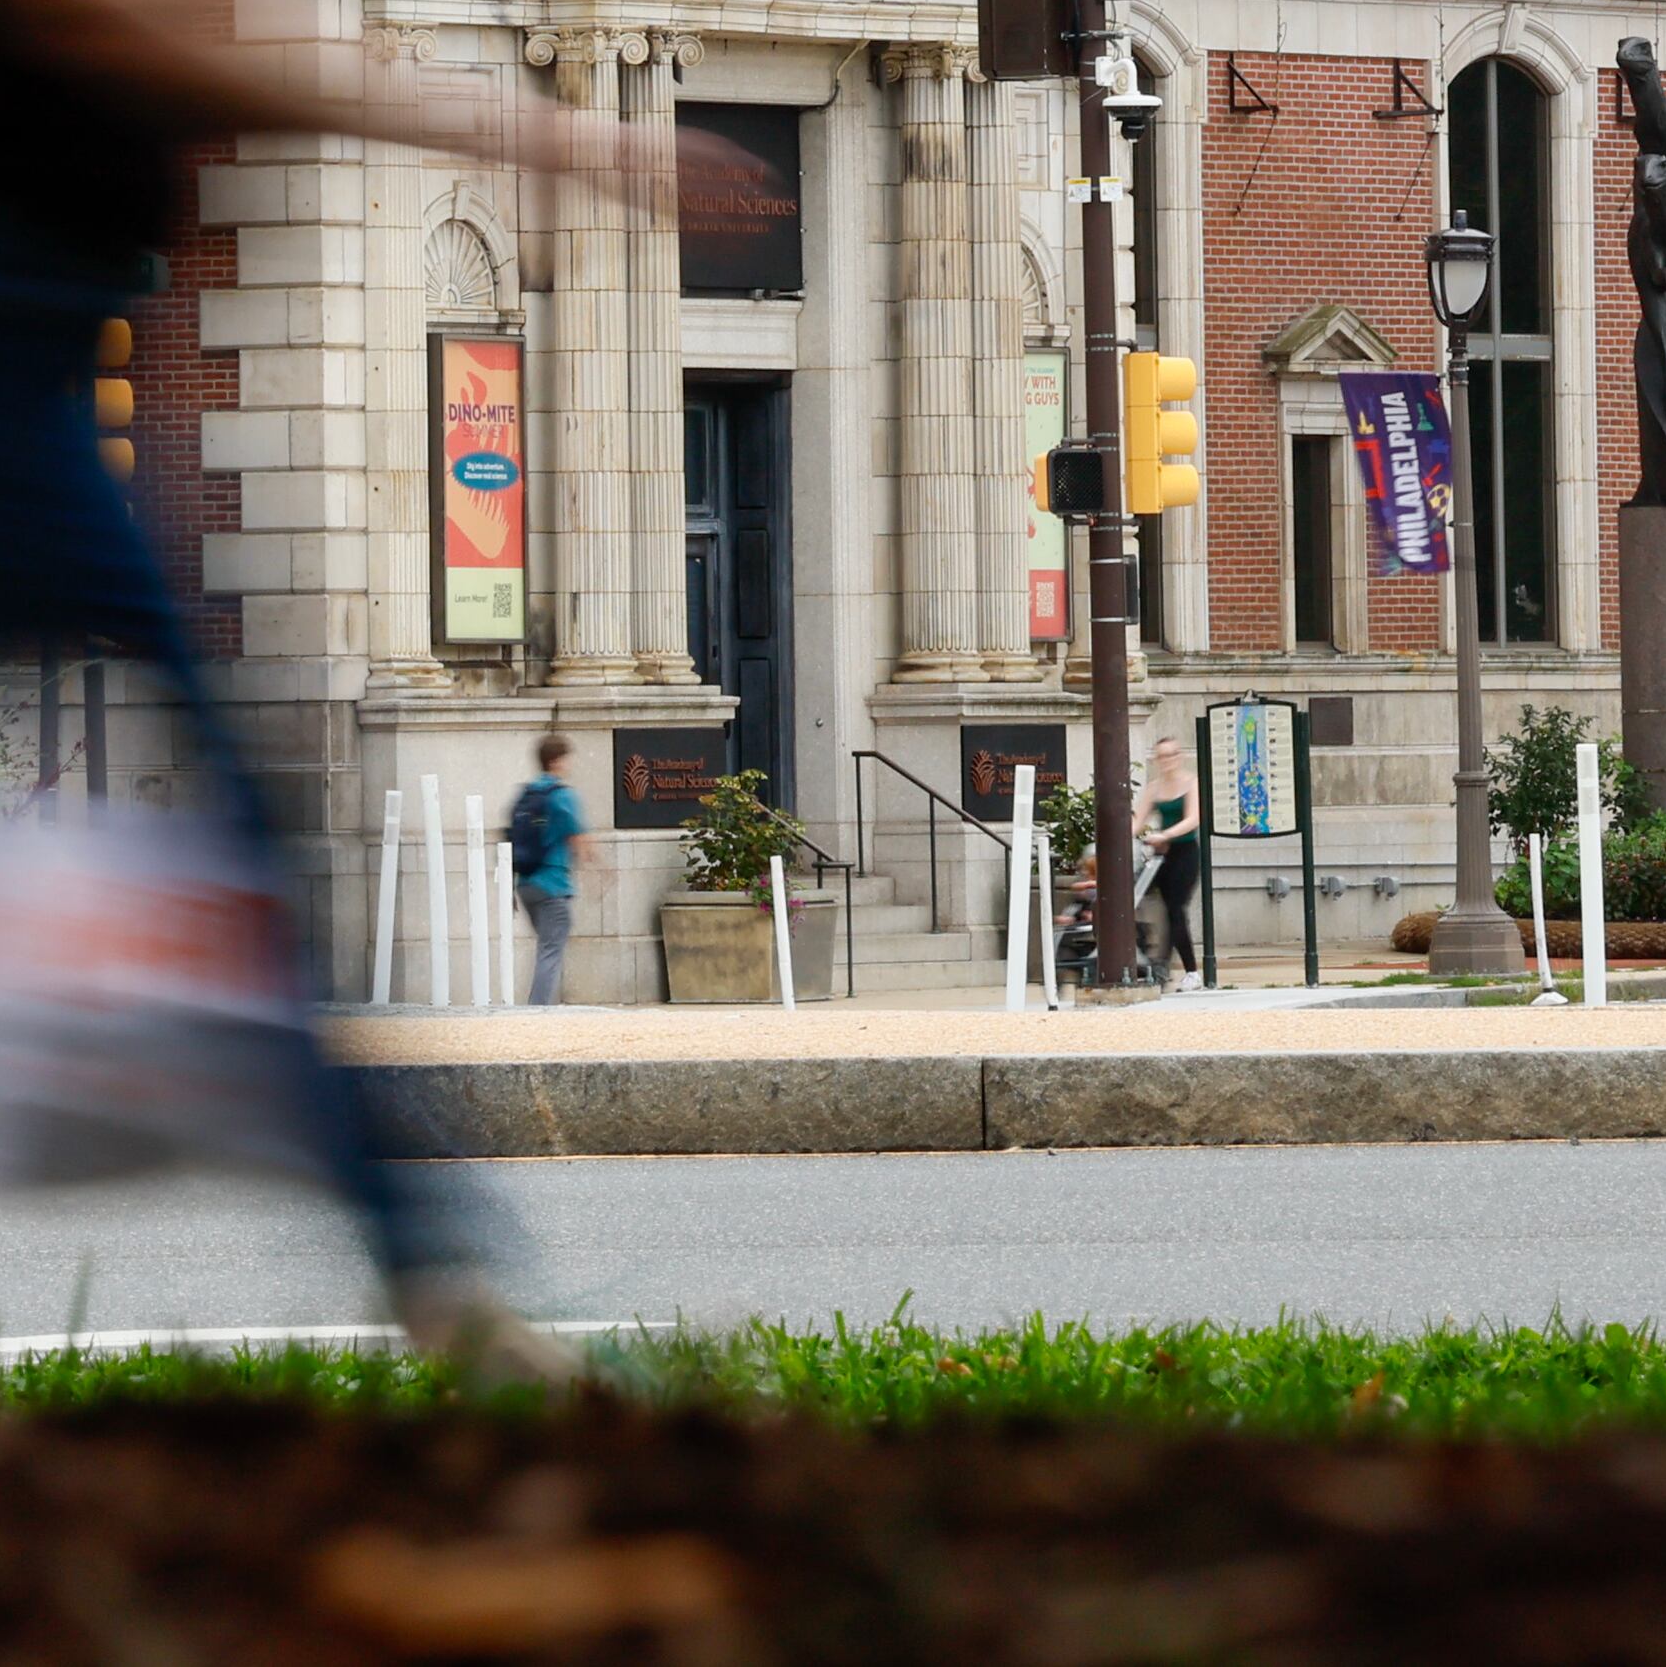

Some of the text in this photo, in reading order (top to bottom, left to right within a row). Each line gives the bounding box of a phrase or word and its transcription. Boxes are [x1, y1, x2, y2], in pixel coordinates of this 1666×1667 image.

[679, 188, 798, 216] Natural Sciences
[1031, 376, 1056, 389] WITH
[1034, 392, 1060, 406] GUYS
[448, 403, 516, 423] DINO-MITE
[1381, 391, 1432, 563] PHILADELPHIA
